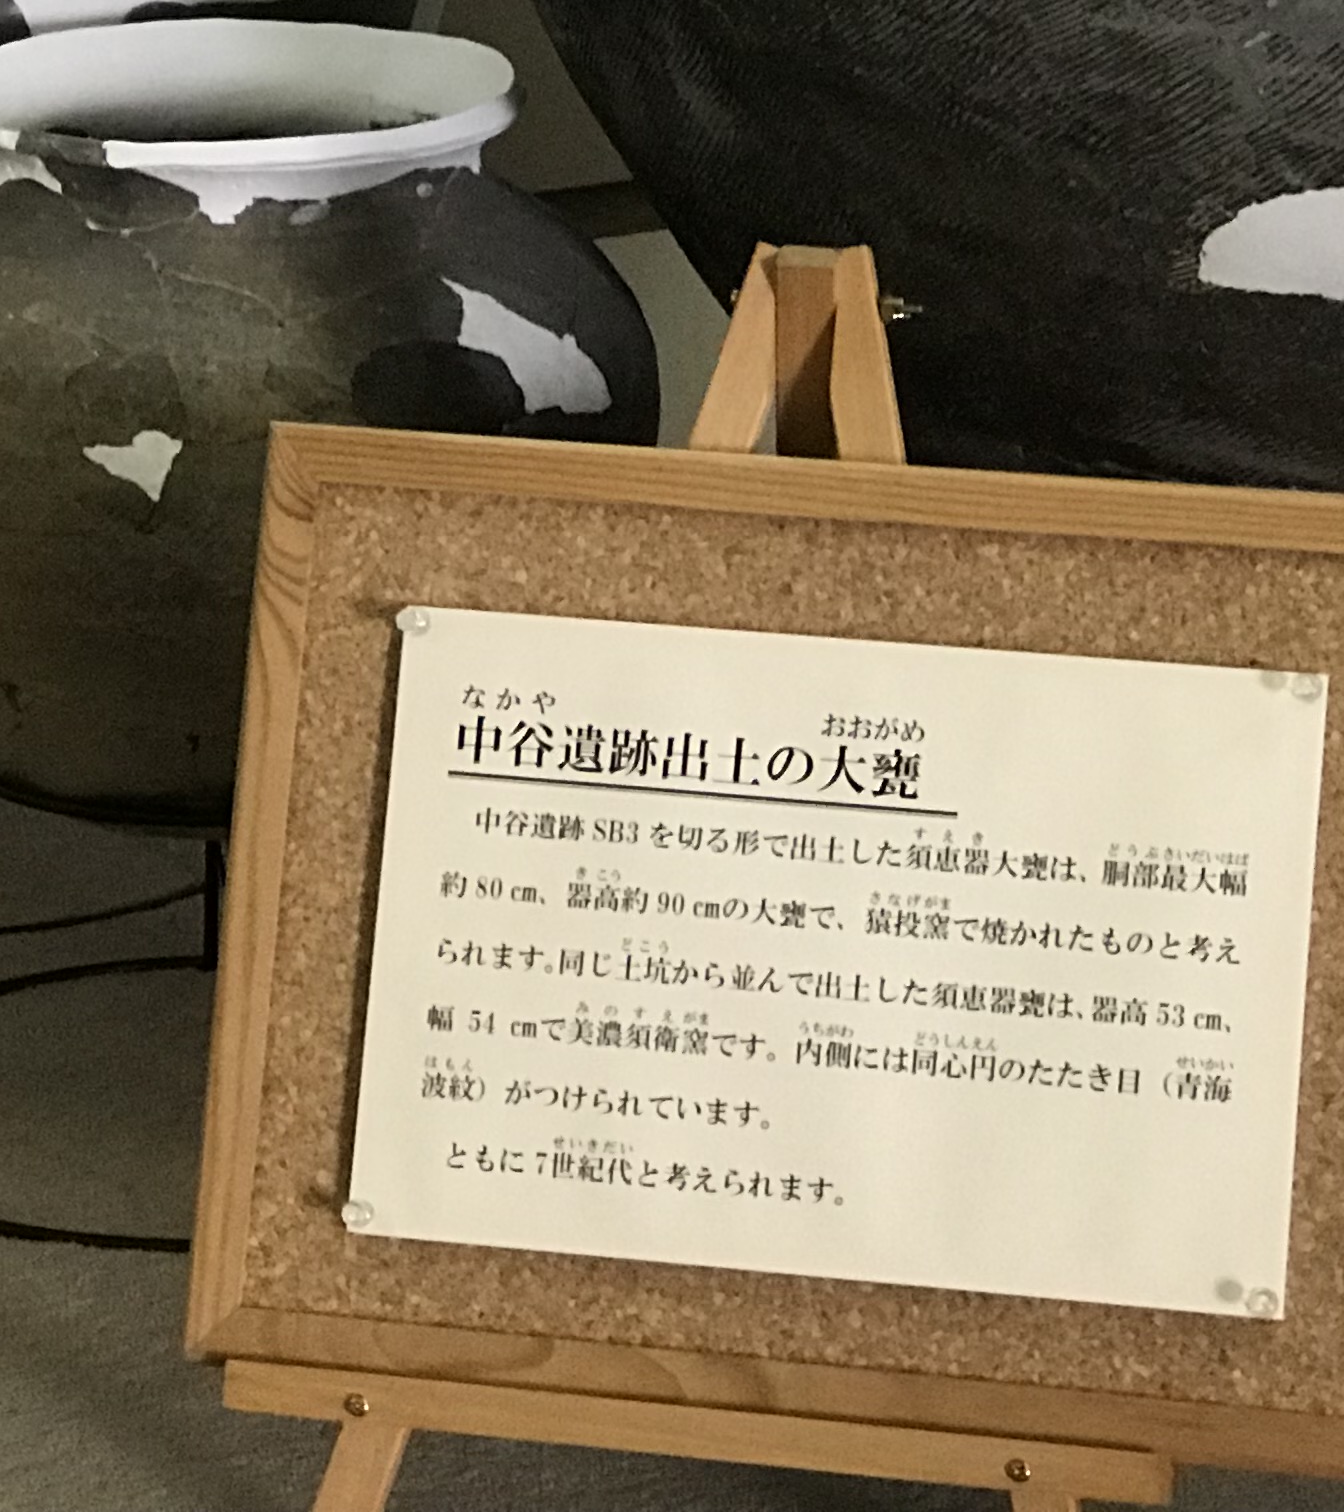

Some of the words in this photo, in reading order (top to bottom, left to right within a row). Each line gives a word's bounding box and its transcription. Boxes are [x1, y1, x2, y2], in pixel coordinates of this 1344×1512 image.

[462, 685, 556, 715] なかや
[821, 713, 926, 743] おおがめ
[455, 715, 922, 800] 中谷遺跡出土の大甕
[913, 827, 984, 846] すえき
